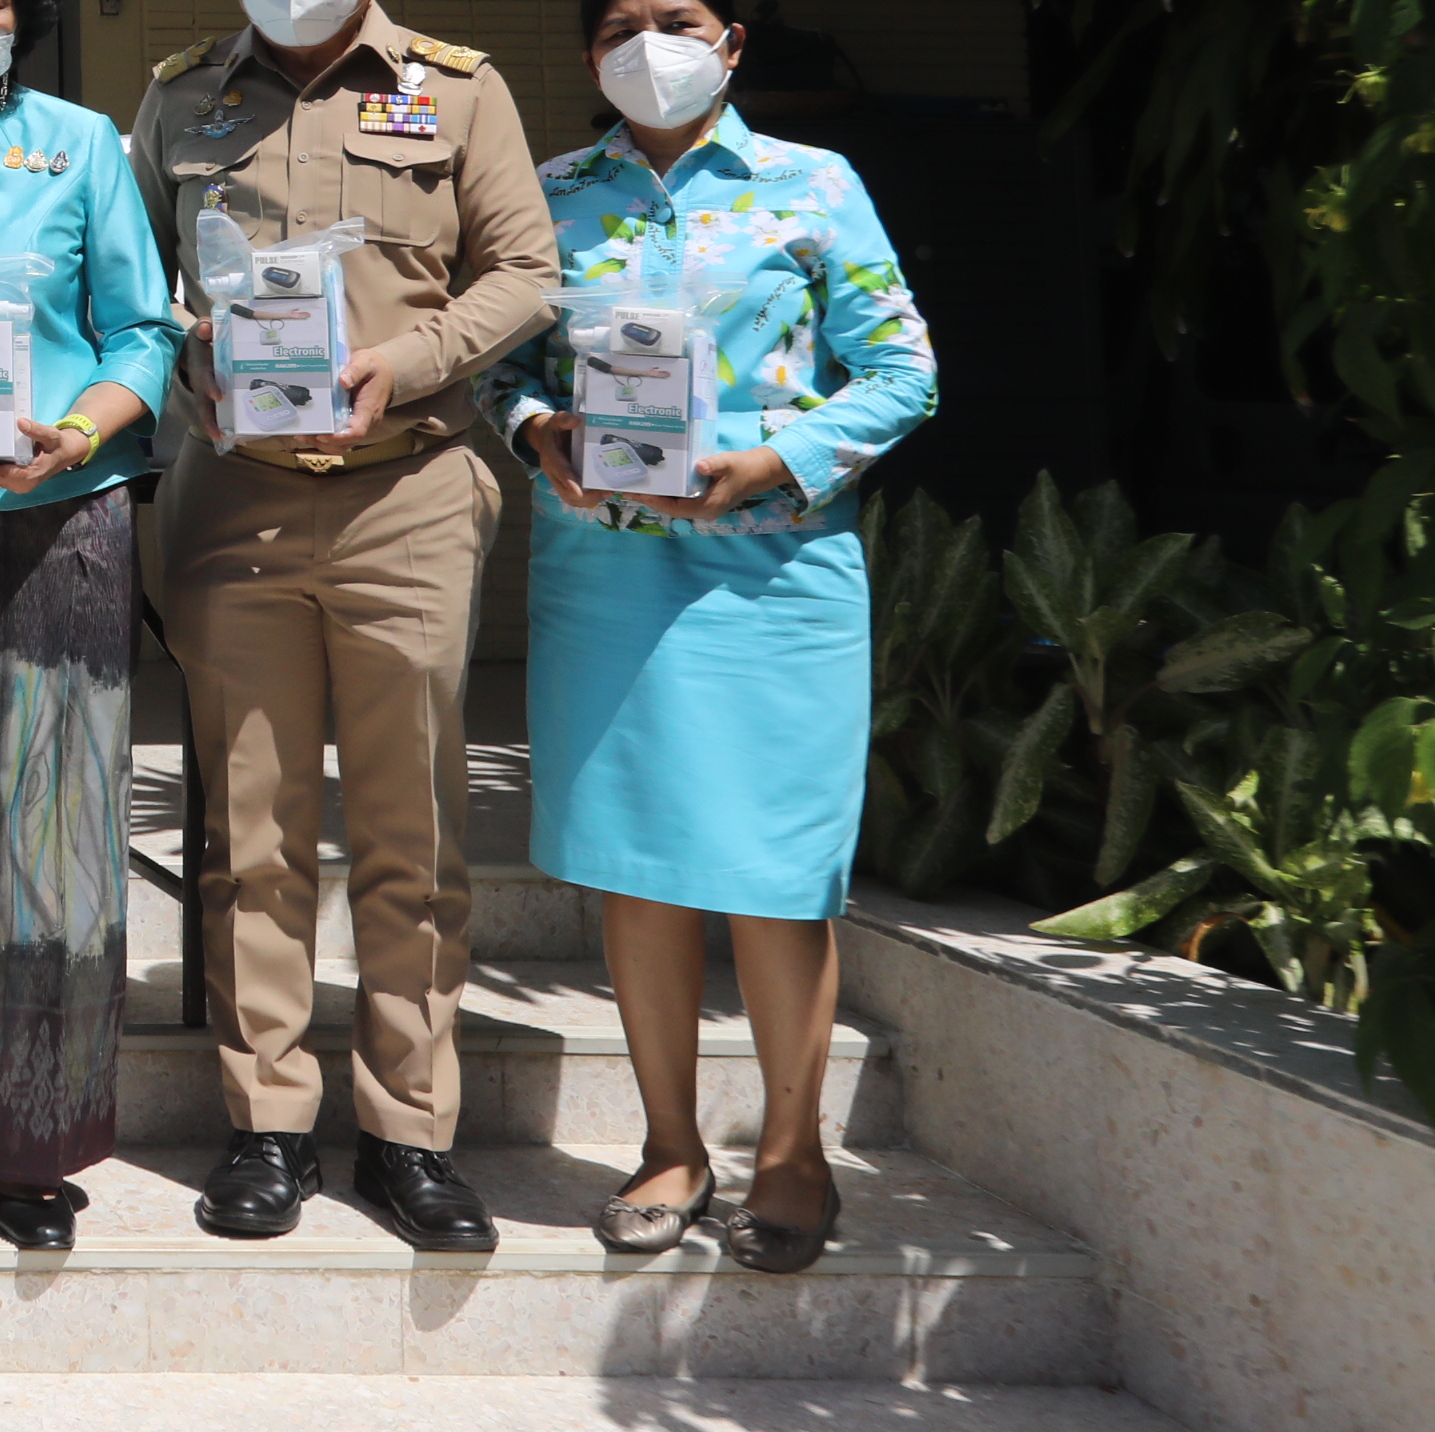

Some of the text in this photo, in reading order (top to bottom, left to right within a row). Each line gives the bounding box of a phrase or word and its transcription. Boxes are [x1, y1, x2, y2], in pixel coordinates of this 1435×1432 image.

[255, 256, 279, 265] PULSE
[615, 311, 639, 321] PULSE
[273, 345, 325, 358] Electronic
[628, 404, 682, 417] Electronic
